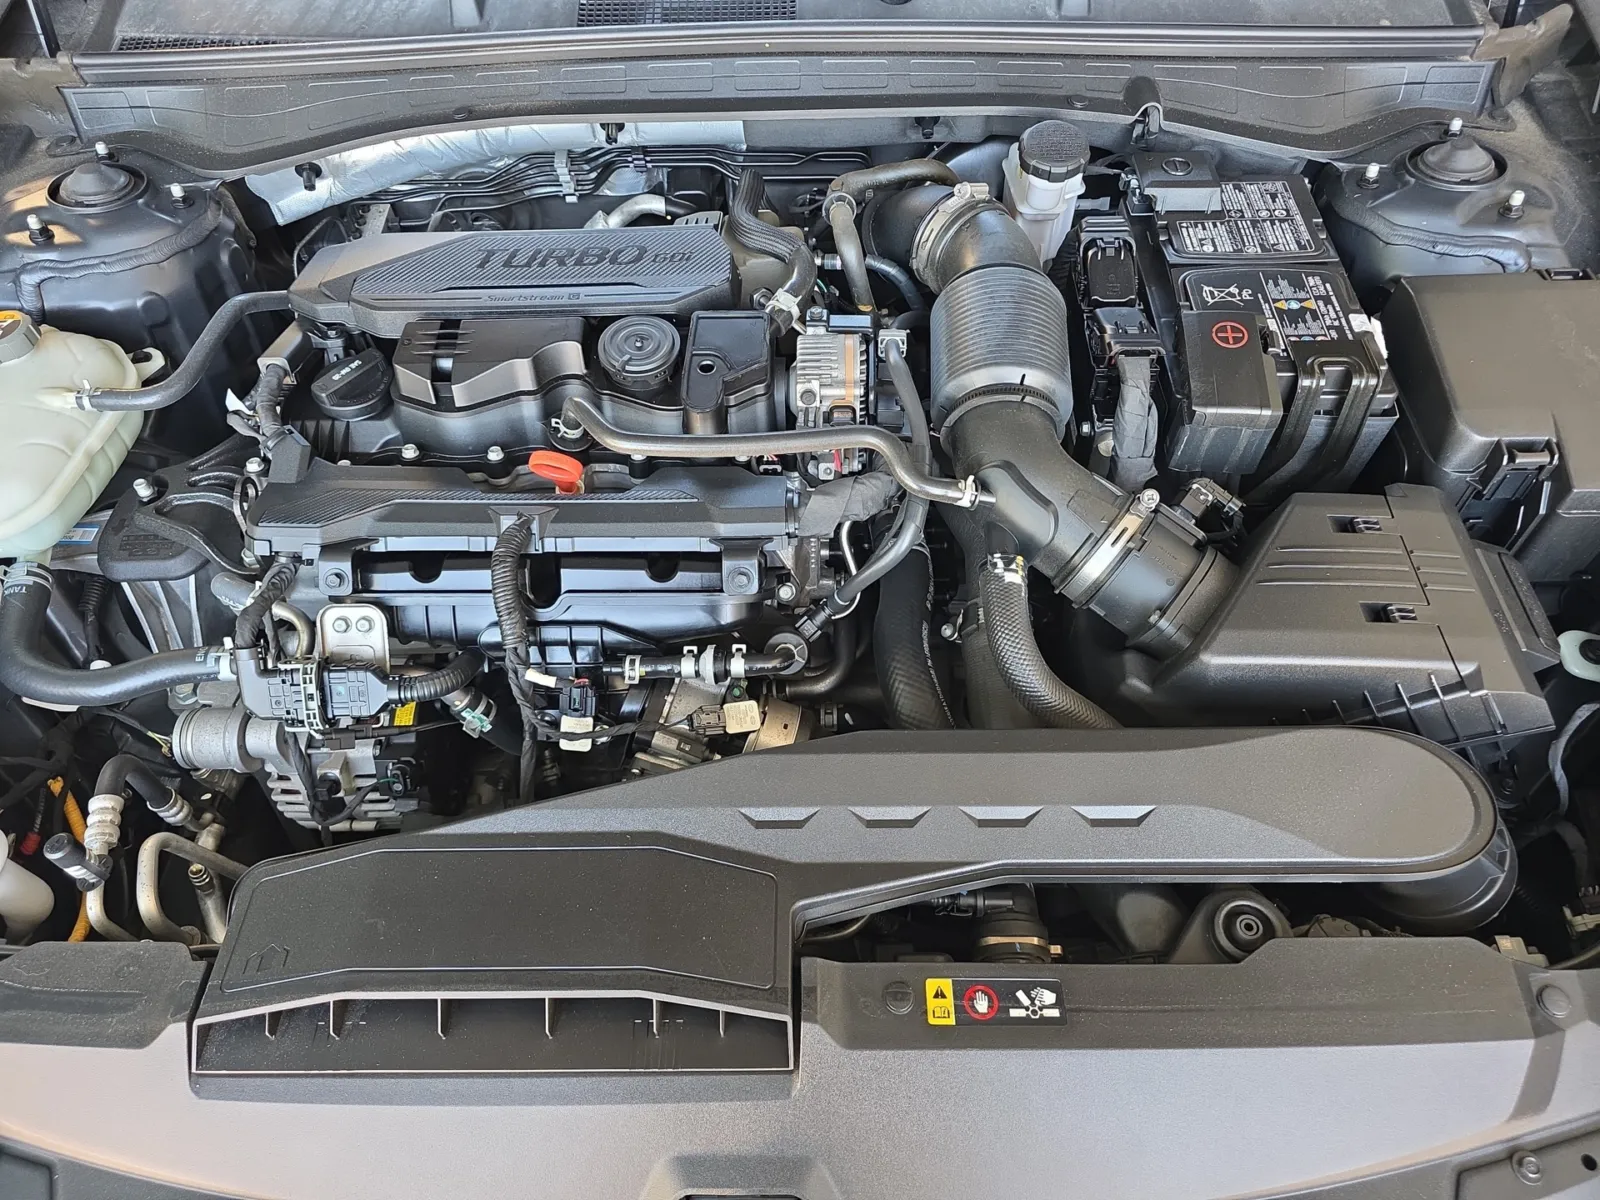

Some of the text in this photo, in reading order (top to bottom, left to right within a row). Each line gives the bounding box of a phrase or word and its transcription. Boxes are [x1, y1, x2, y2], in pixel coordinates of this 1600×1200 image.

[475, 245, 647, 269] TURBO
[487, 293, 564, 302] Smartstream
[1241, 288, 1254, 300] Pb
[348, 360, 362, 369] SAE
[3, 585, 27, 597] TANK
